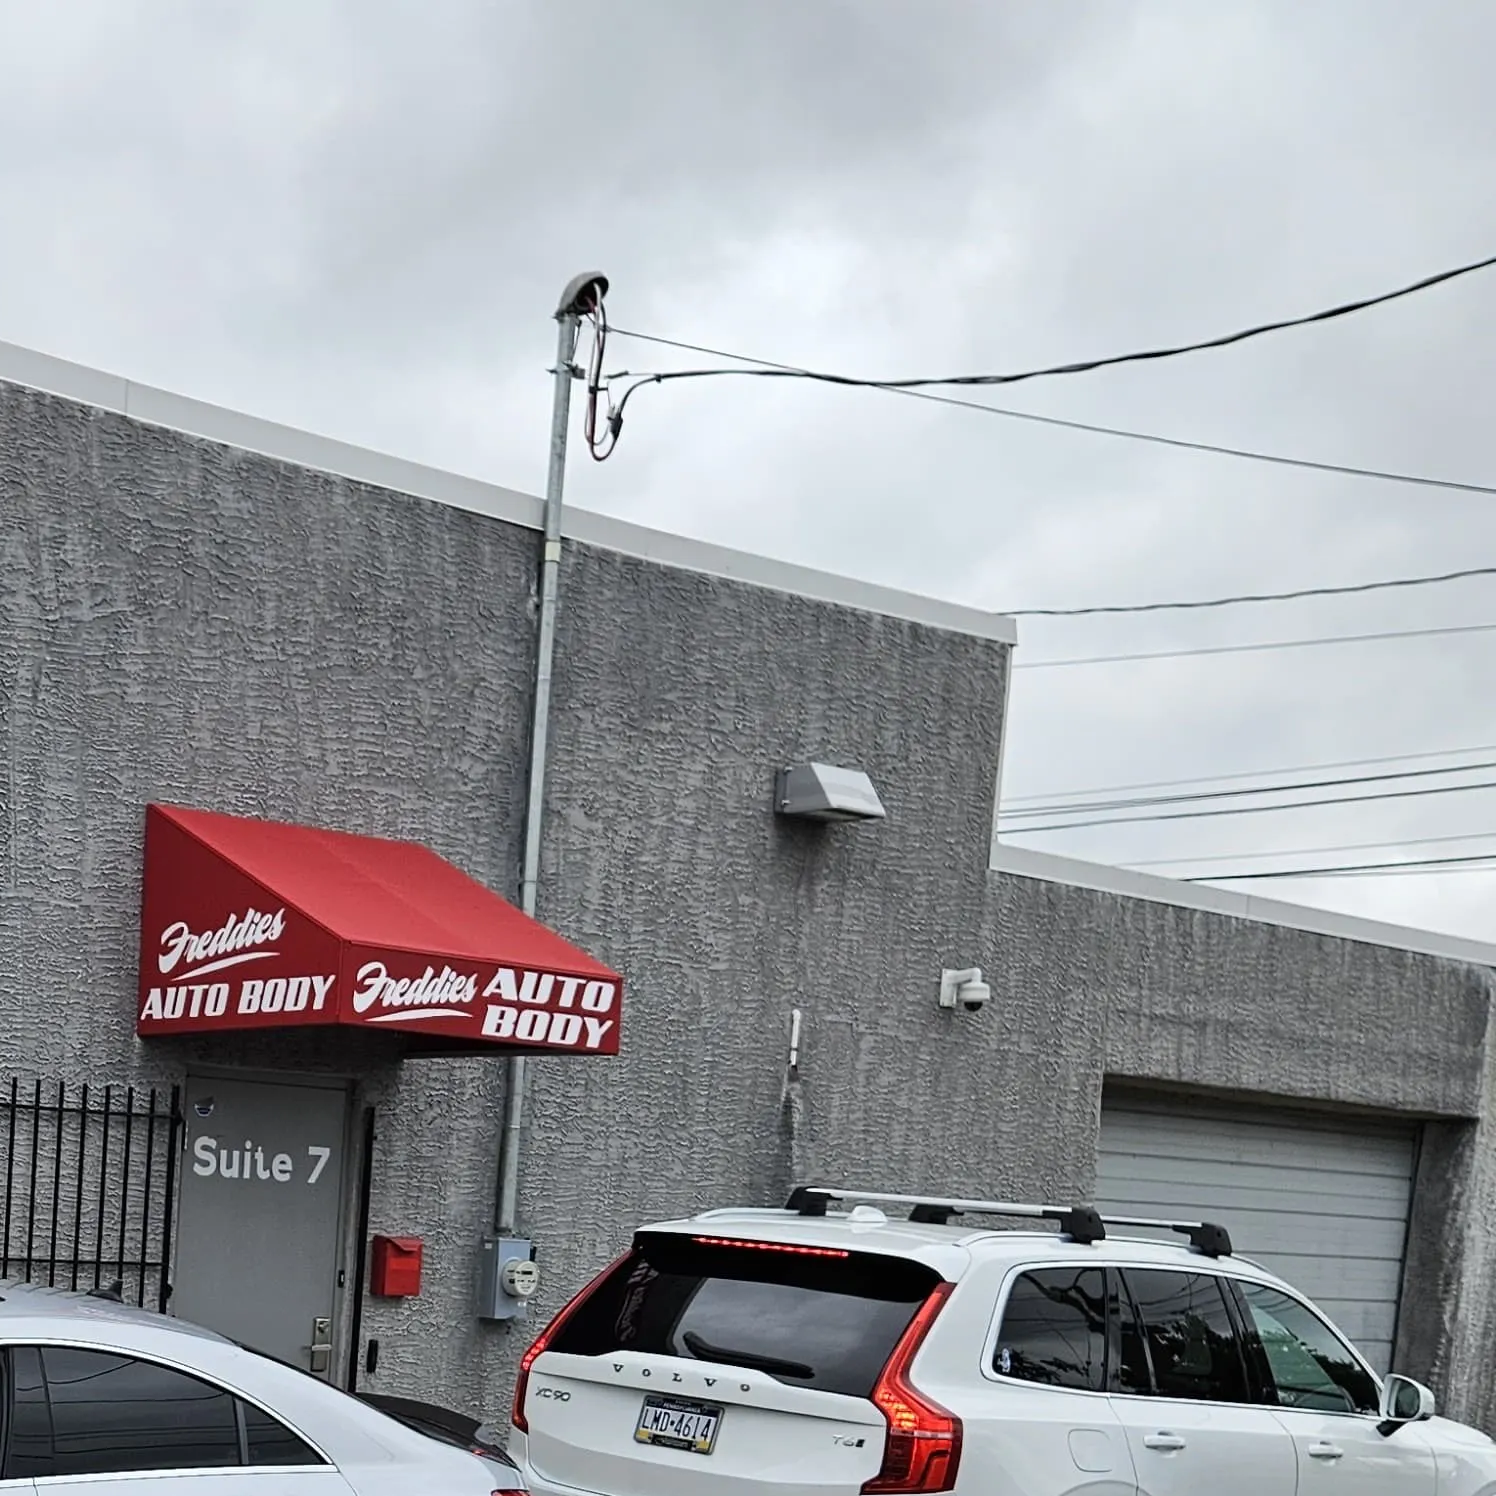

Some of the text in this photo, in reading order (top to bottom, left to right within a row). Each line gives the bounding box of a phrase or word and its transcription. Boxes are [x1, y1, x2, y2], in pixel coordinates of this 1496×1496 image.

[158, 907, 285, 974] Freddies
[141, 974, 336, 1020] AUTO BODY
[353, 961, 478, 1014] Freddies
[482, 967, 616, 1013] AUTO
[481, 1009, 613, 1049] BODY
[192, 1135, 331, 1184] Suite 7
[535, 1387, 572, 1402] XC90
[612, 1363, 752, 1393] VOLVO
